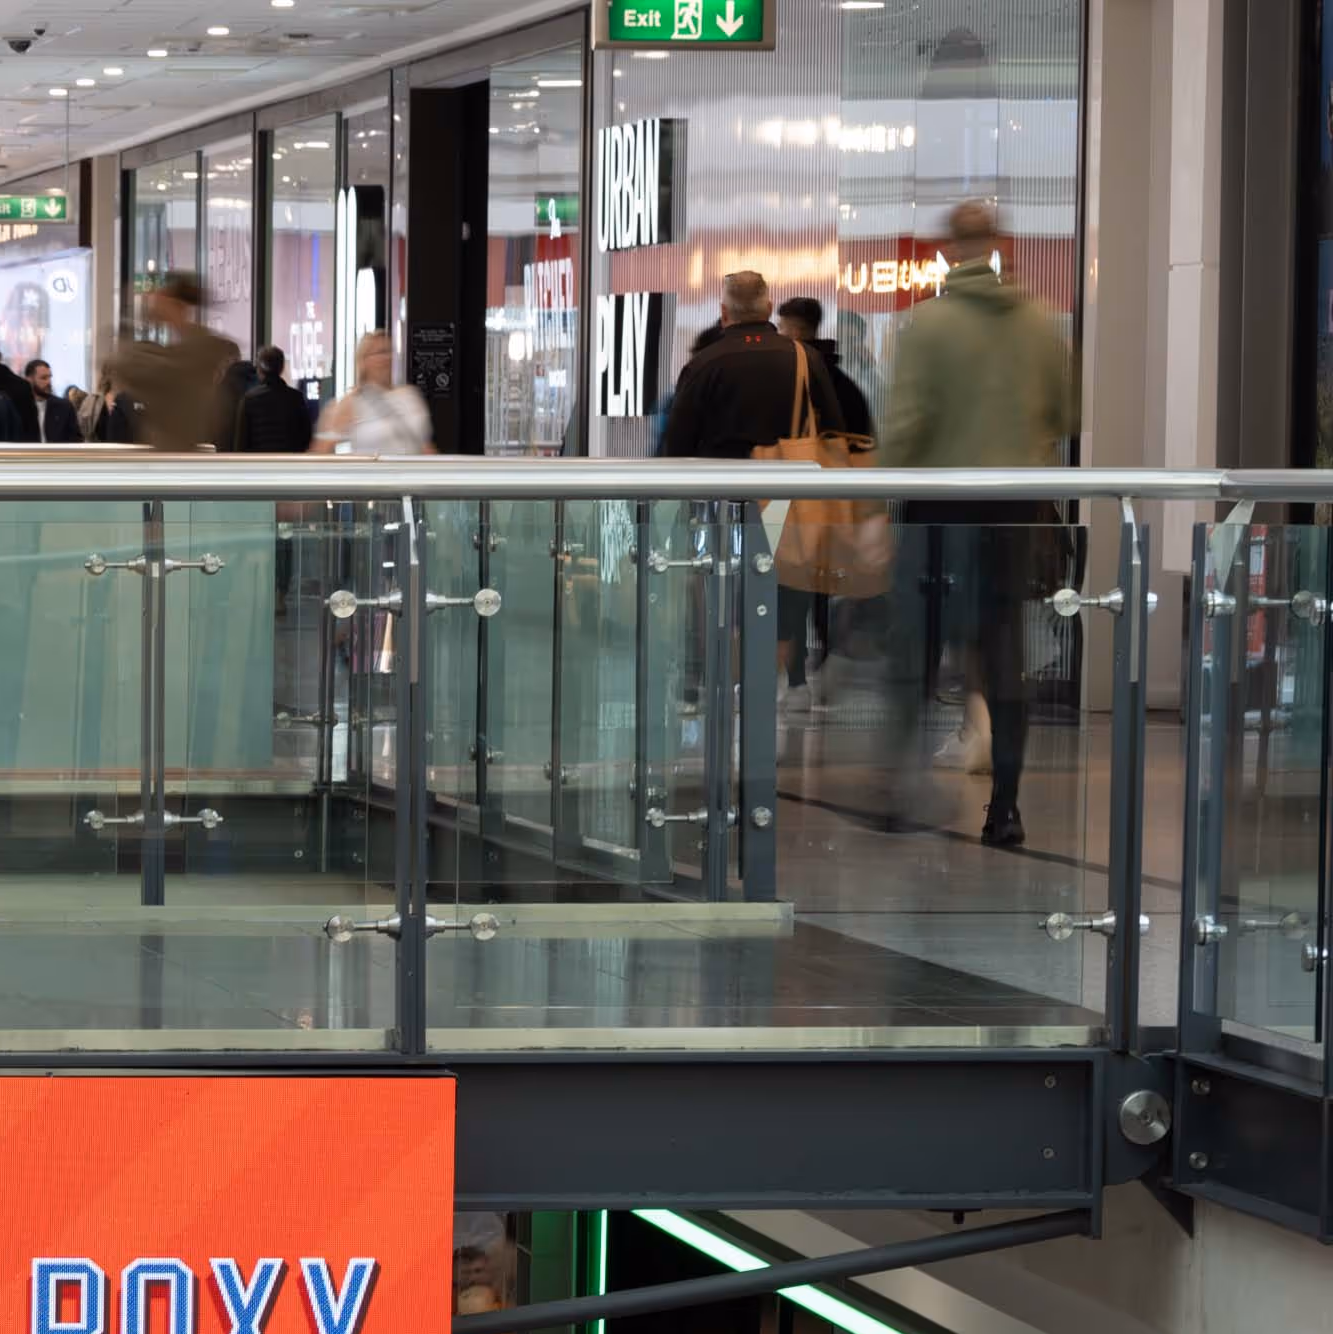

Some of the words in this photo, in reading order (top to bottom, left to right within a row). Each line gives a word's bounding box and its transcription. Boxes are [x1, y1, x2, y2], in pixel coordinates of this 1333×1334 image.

[624, 9, 661, 27] Exit
[598, 118, 661, 252] URBAN
[596, 291, 649, 417] PLAY
